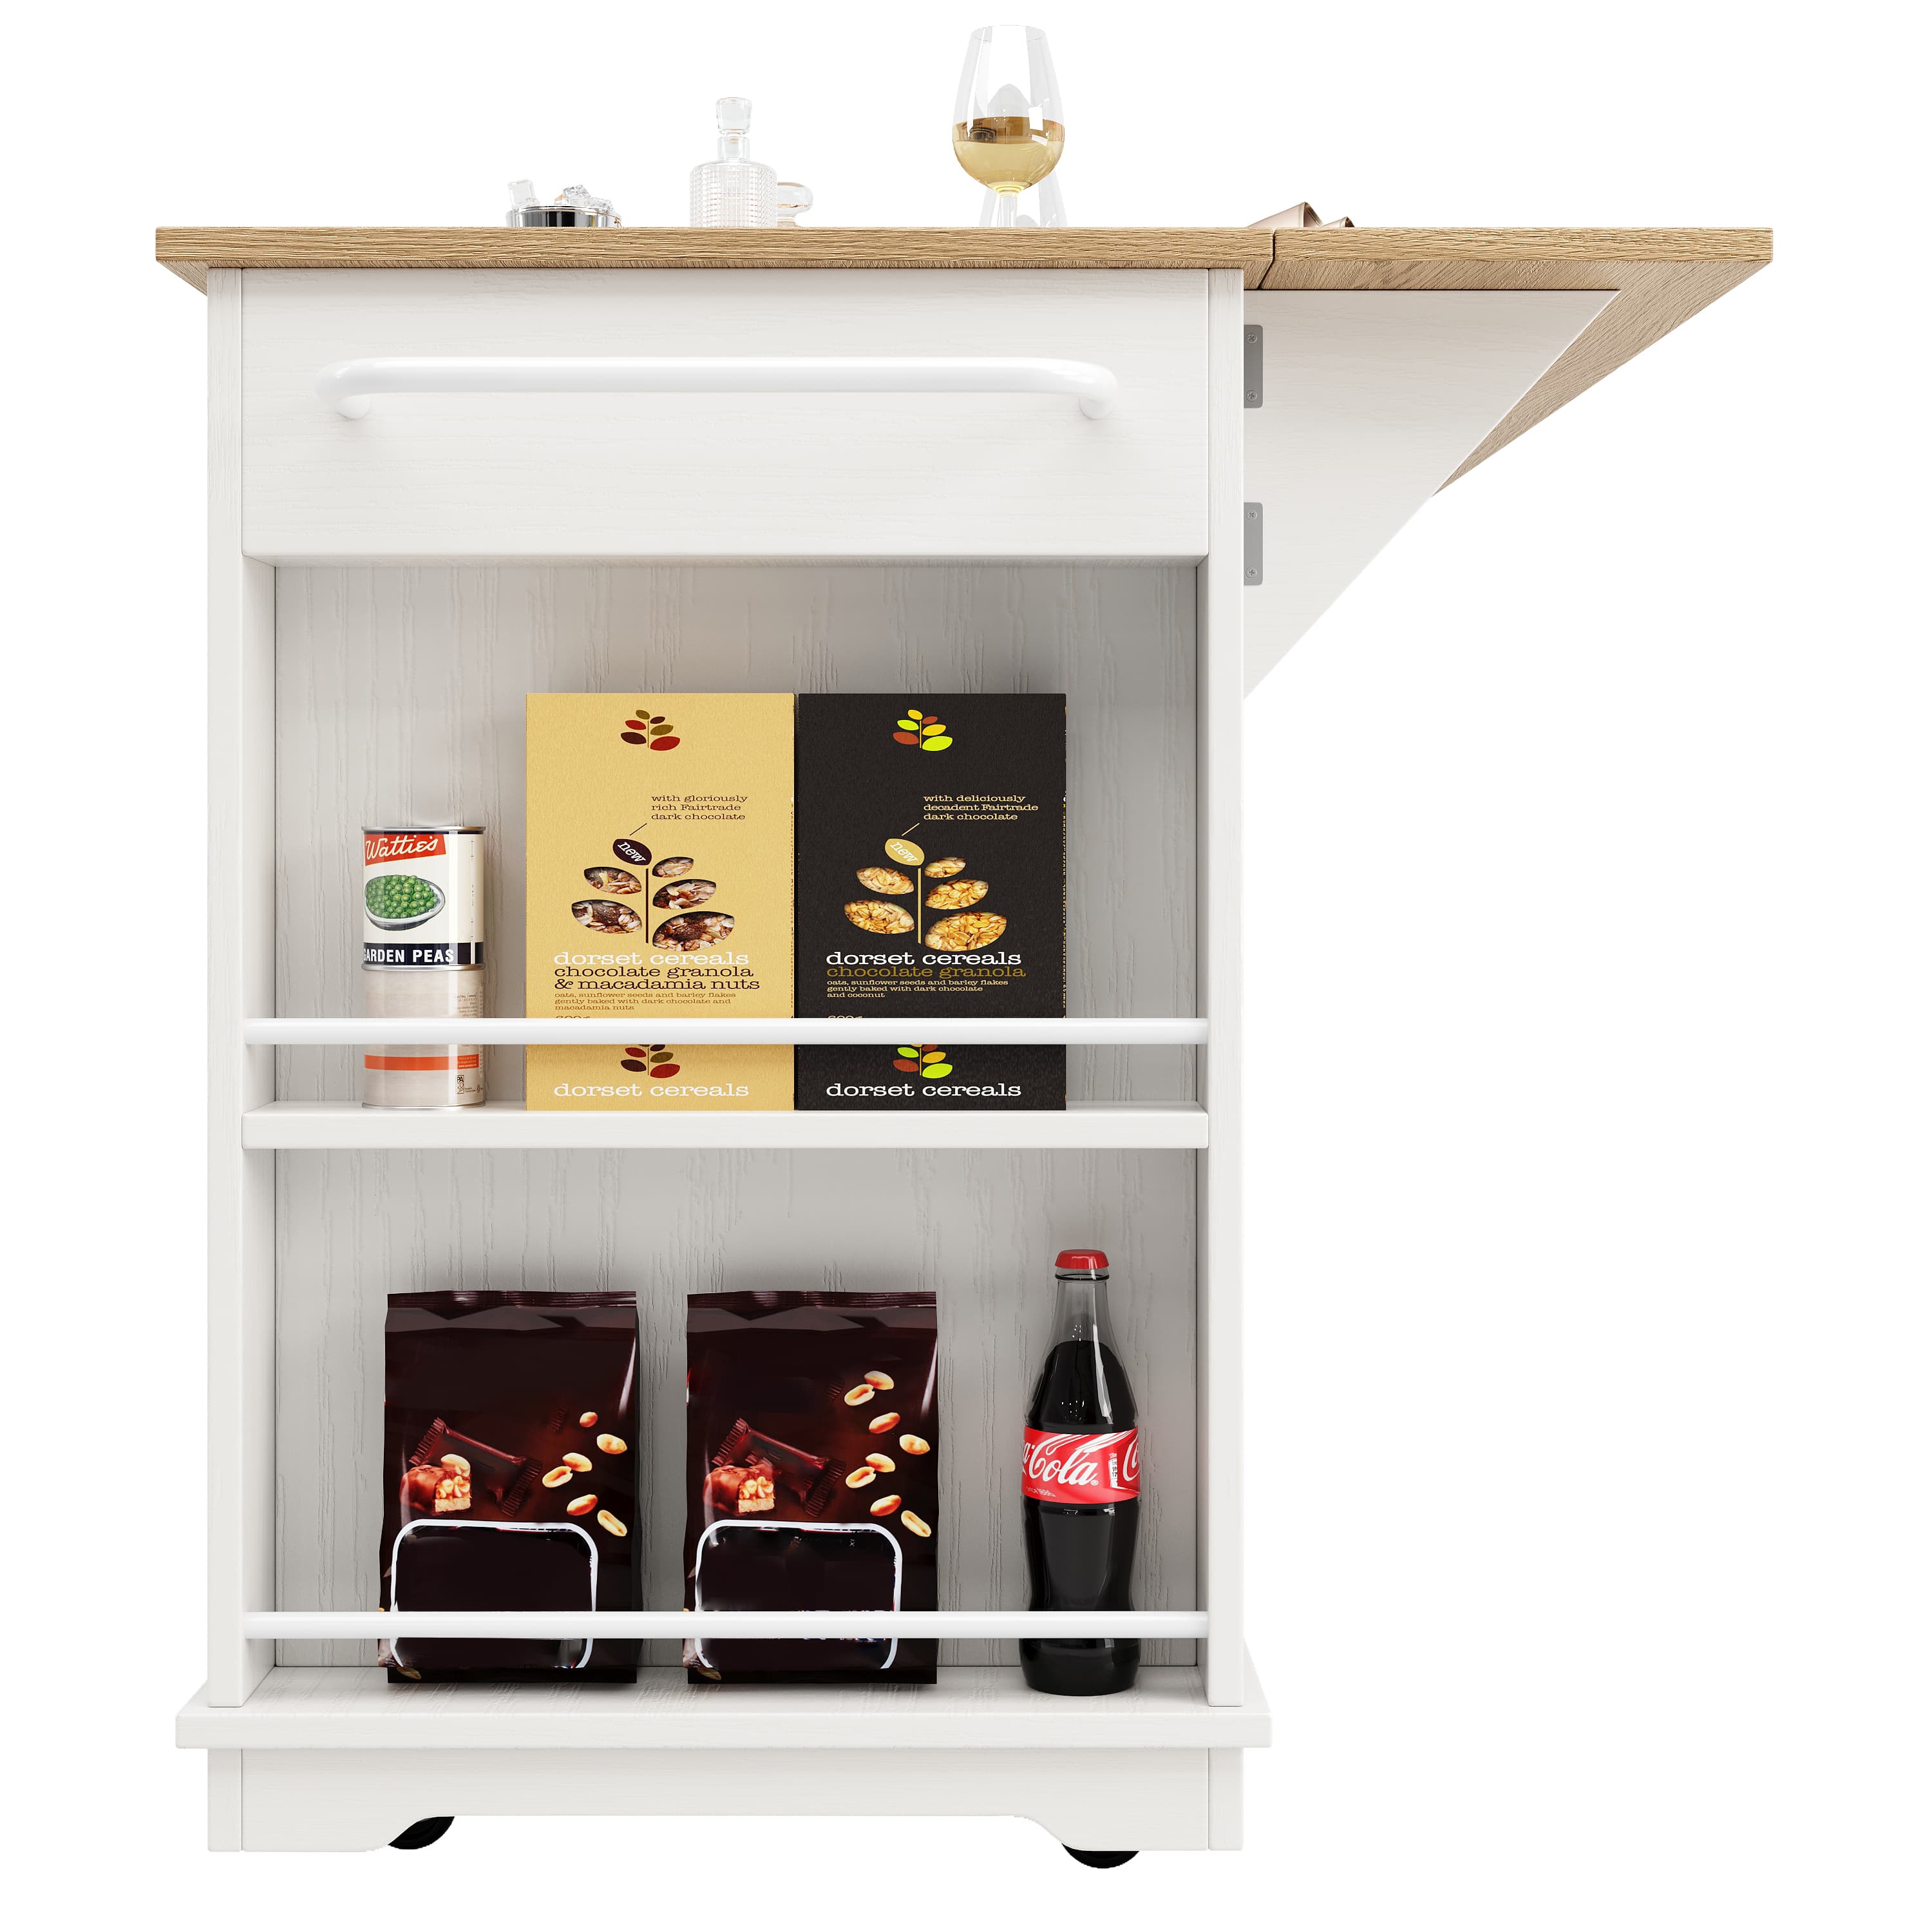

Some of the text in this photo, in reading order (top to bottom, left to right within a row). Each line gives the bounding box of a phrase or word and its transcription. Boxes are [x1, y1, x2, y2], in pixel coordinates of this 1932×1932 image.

[683, 795, 748, 803] gloriously
[923, 794, 1026, 803] with deliciously
[617, 841, 647, 862] new
[889, 841, 918, 862] new
[412, 949, 455, 962] PEAS
[554, 952, 749, 965] dorset cereals
[826, 951, 1022, 965] dorset cereals
[554, 966, 754, 979] chocolate granola
[827, 966, 1027, 979] chocolate granola
[554, 978, 761, 990] & macadamia nuts
[554, 1083, 749, 1096] dorset cereals
[826, 1083, 1022, 1097] dorset cereals
